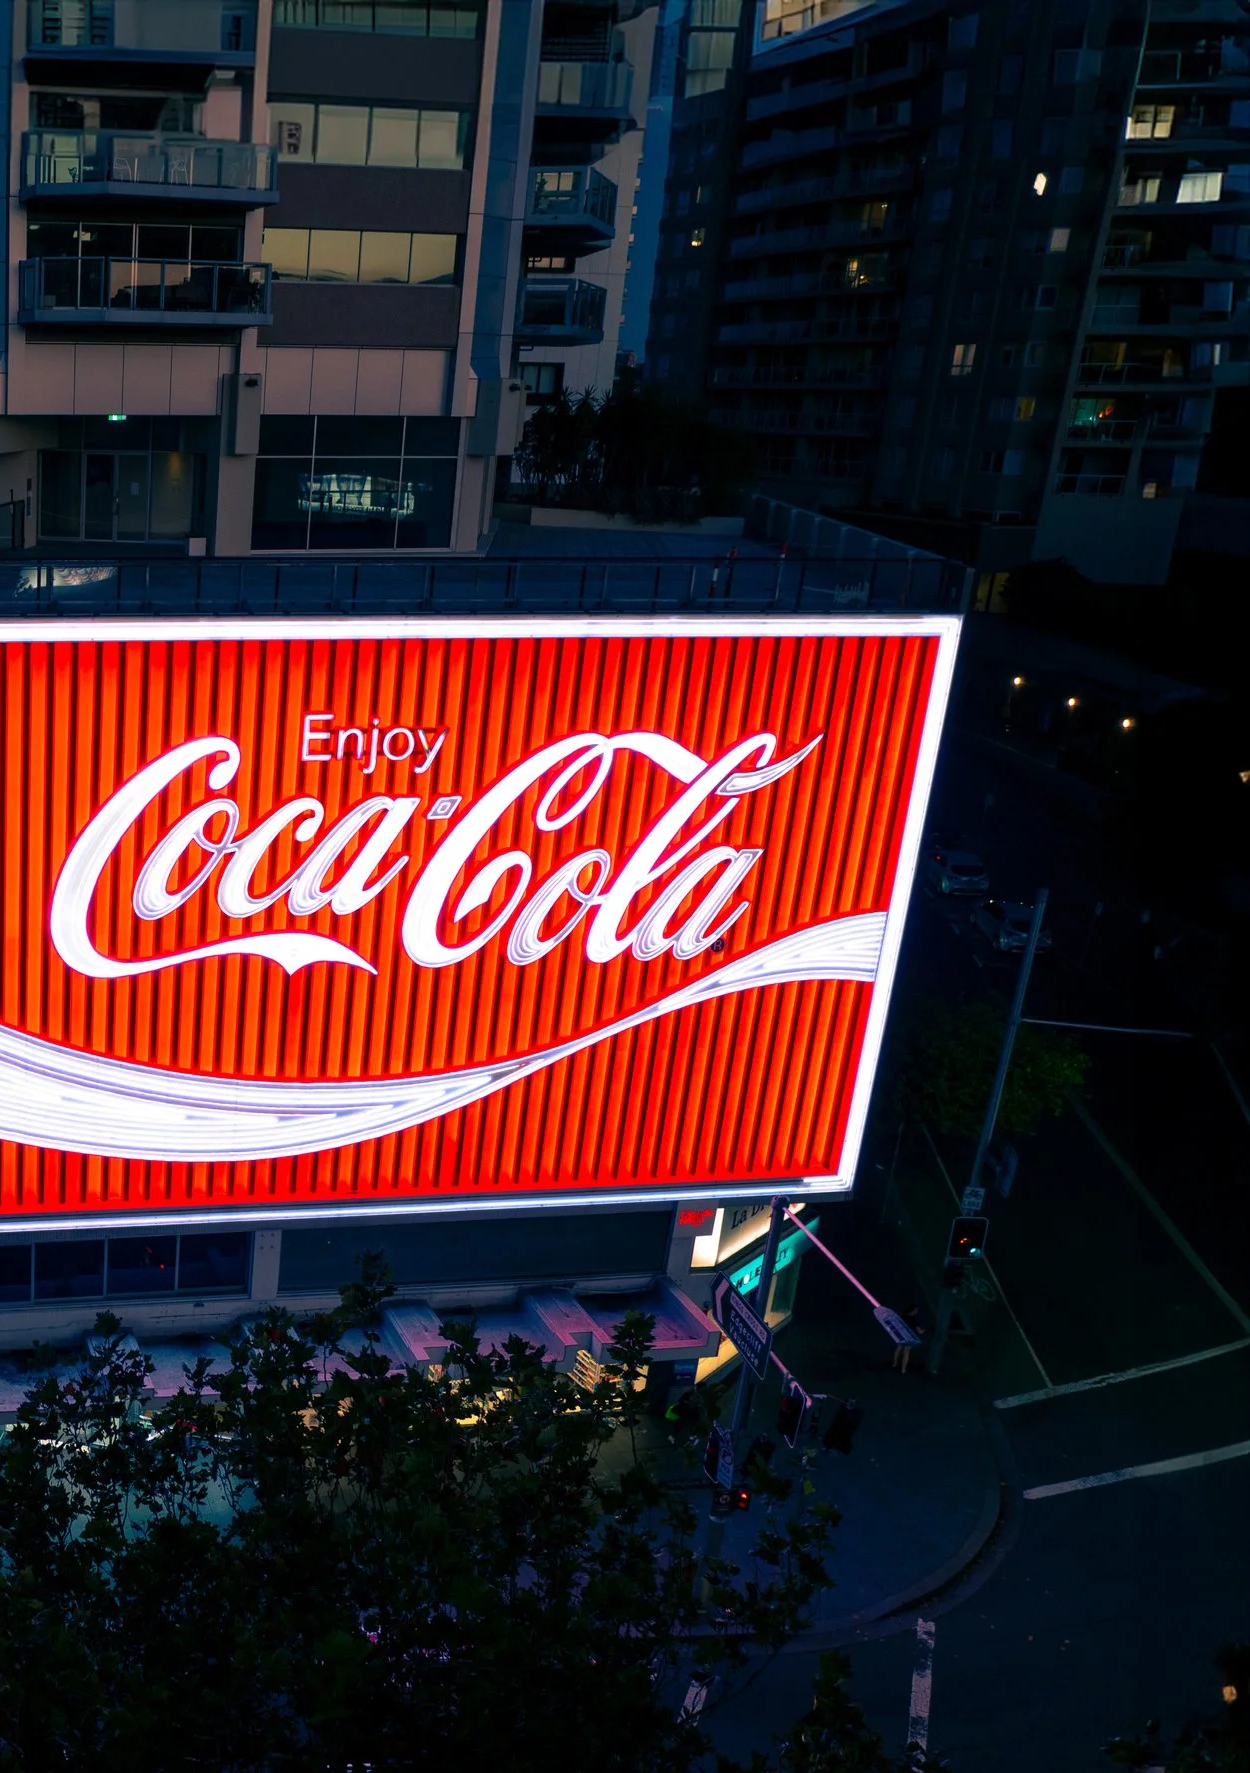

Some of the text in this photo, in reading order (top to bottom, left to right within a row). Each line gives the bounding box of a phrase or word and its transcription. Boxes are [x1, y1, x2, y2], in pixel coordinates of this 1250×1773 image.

[301, 713, 449, 775] Enjoy
[729, 1321, 759, 1368] Vaucluse
[730, 1309, 762, 1353] Edgecliff
